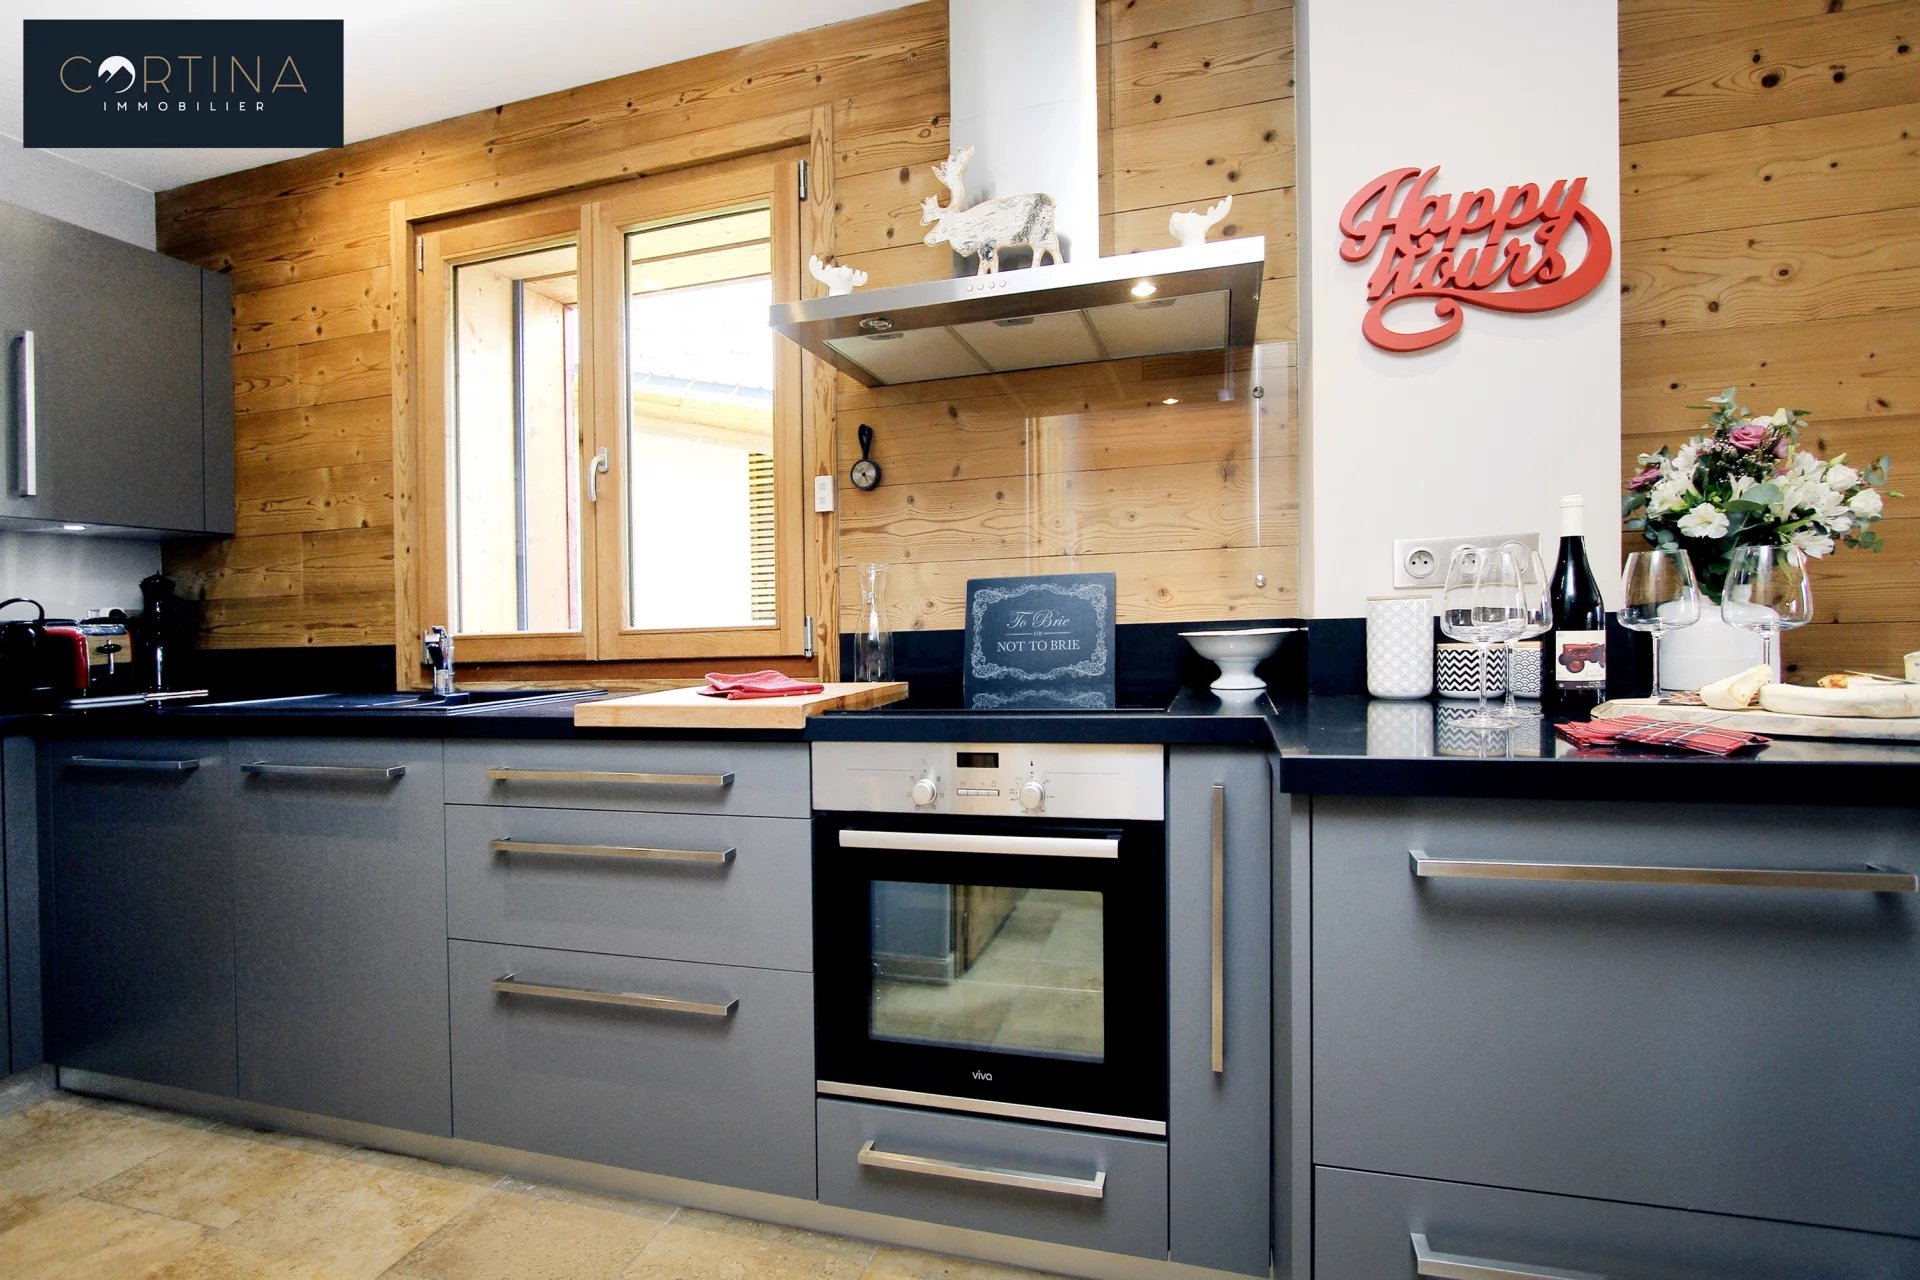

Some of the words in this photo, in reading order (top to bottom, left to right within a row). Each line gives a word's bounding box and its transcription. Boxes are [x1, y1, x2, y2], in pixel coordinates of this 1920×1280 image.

[1339, 165, 1612, 262] Happy
[1006, 610, 1033, 629] To
[1031, 609, 1071, 628] Brie
[997, 641, 1026, 653] NOT
[1028, 640, 1048, 652] TO
[1050, 639, 1080, 651] BRIE
[971, 1069, 993, 1081] viva
